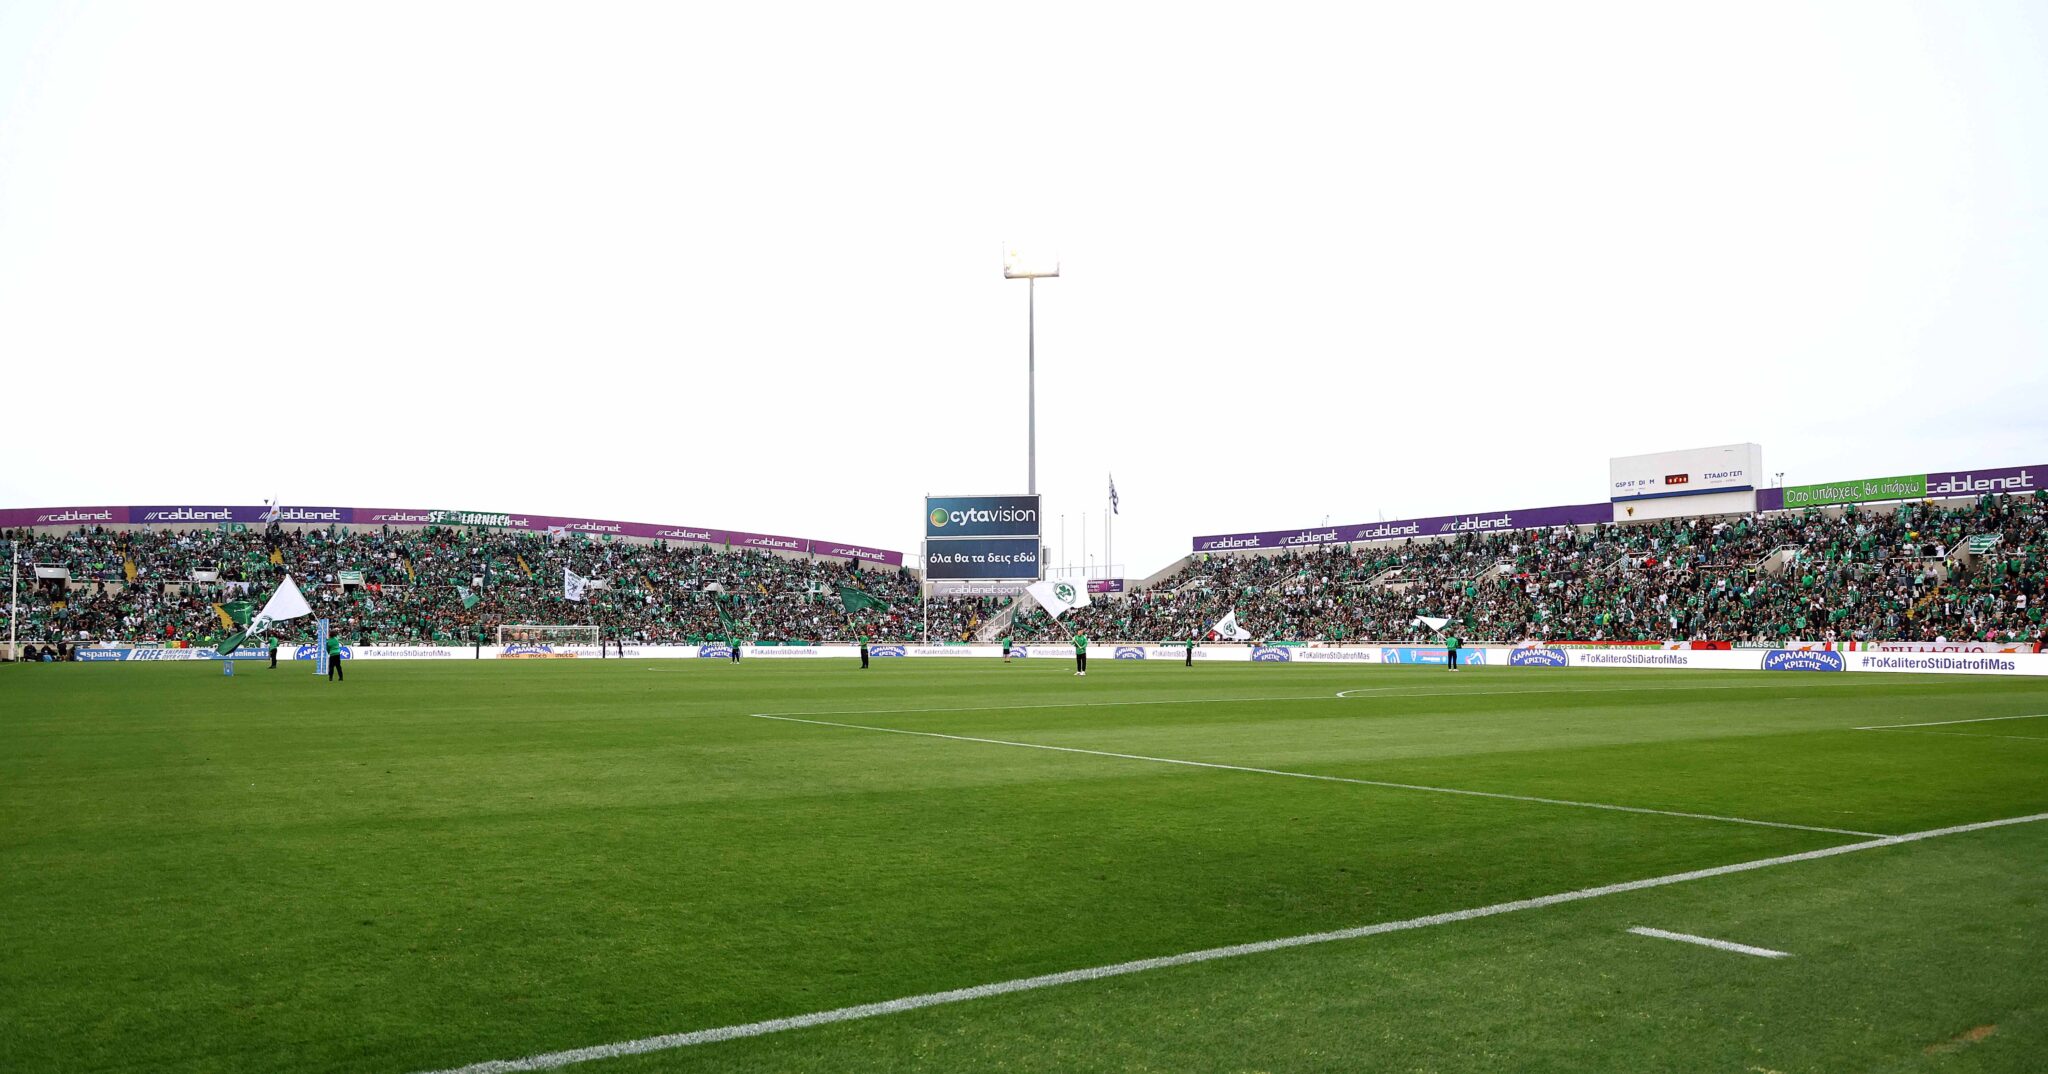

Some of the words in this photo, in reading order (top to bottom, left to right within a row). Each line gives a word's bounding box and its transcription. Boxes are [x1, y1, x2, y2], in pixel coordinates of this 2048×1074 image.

[48, 510, 112, 522] cablenet
[158, 508, 232, 520] cablenet
[282, 508, 340, 521] ablenet
[381, 512, 430, 522] cablene
[950, 506, 1036, 526] cytavision
[573, 522, 622, 532] cablenet
[1451, 514, 1512, 531] cablenet
[664, 530, 711, 540] cablenet
[1365, 522, 1419, 538] cablenet
[1210, 535, 1260, 549] cablenet
[1288, 529, 1338, 544] cablenet
[752, 538, 798, 549] cablenet
[839, 548, 885, 560] cablenet
[930, 552, 951, 563] όλα
[954, 553, 969, 563] θα
[972, 555, 985, 563] τα
[987, 552, 1011, 564] δεις
[1013, 551, 1036, 562] εδώ
[949, 584, 997, 594] cablenet
[1736, 640, 1780, 649] LIMASSOL
[134, 650, 163, 660] FREE
[1580, 653, 1687, 665] #ToKaliteroStiDiatrofiMas
[1767, 650, 1840, 669] ΧΑΡΑΛΑΜΠΙΔΗΣ
[1783, 660, 1822, 670] ΚΡΙΣΤΗΣ
[1862, 656, 2015, 670] #ToKaliteroStiDiatrofiMas
